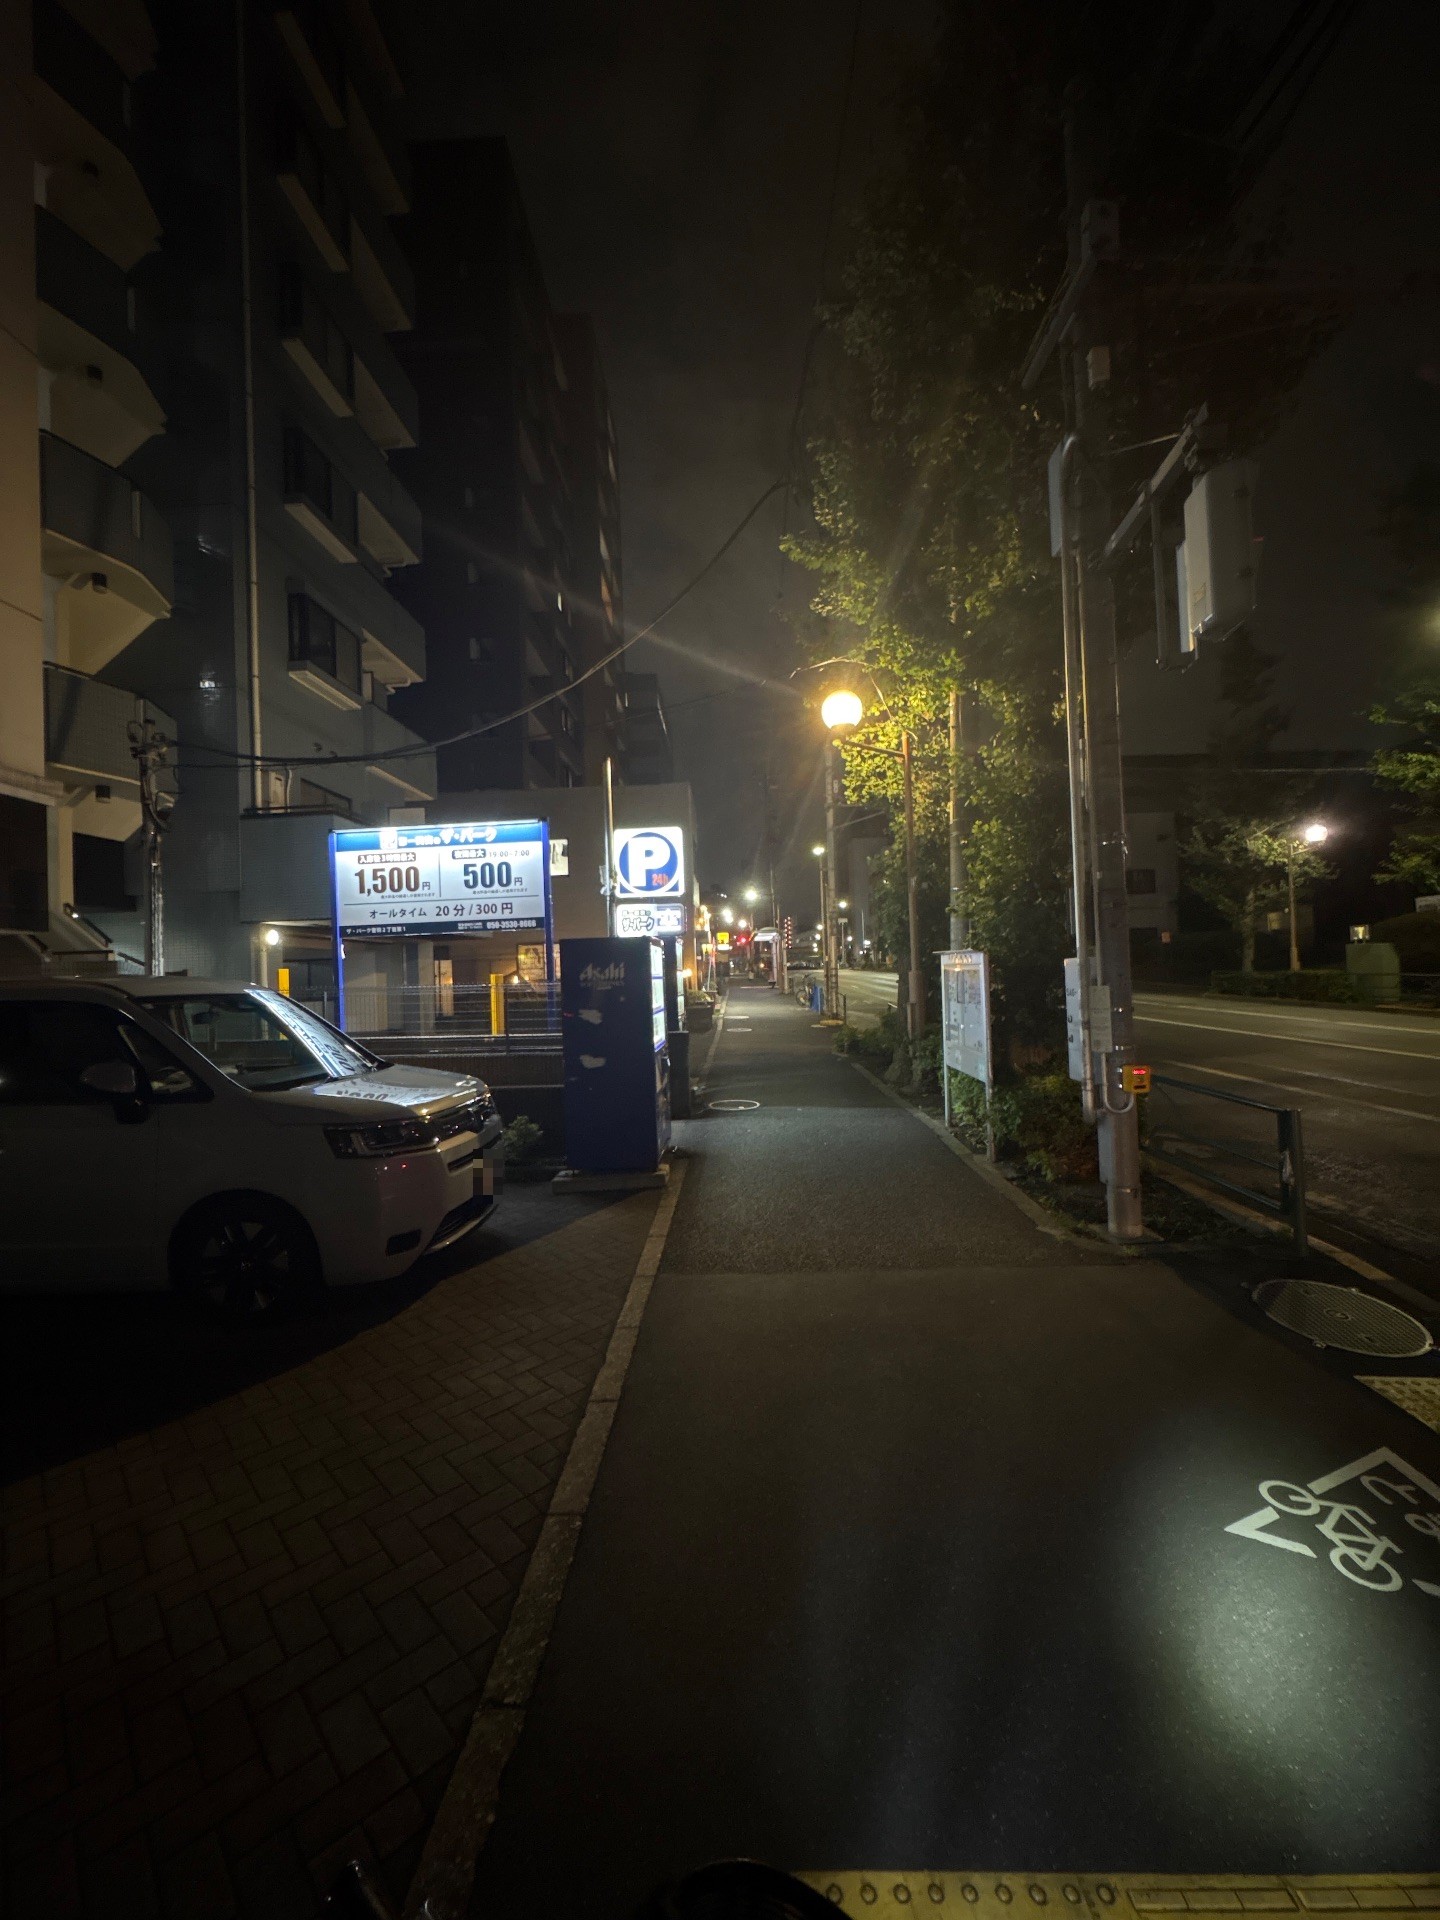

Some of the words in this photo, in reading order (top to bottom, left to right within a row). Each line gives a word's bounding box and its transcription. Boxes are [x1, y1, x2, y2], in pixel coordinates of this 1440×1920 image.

[628, 836, 671, 887] P
[369, 907, 427, 918] オールタイム
